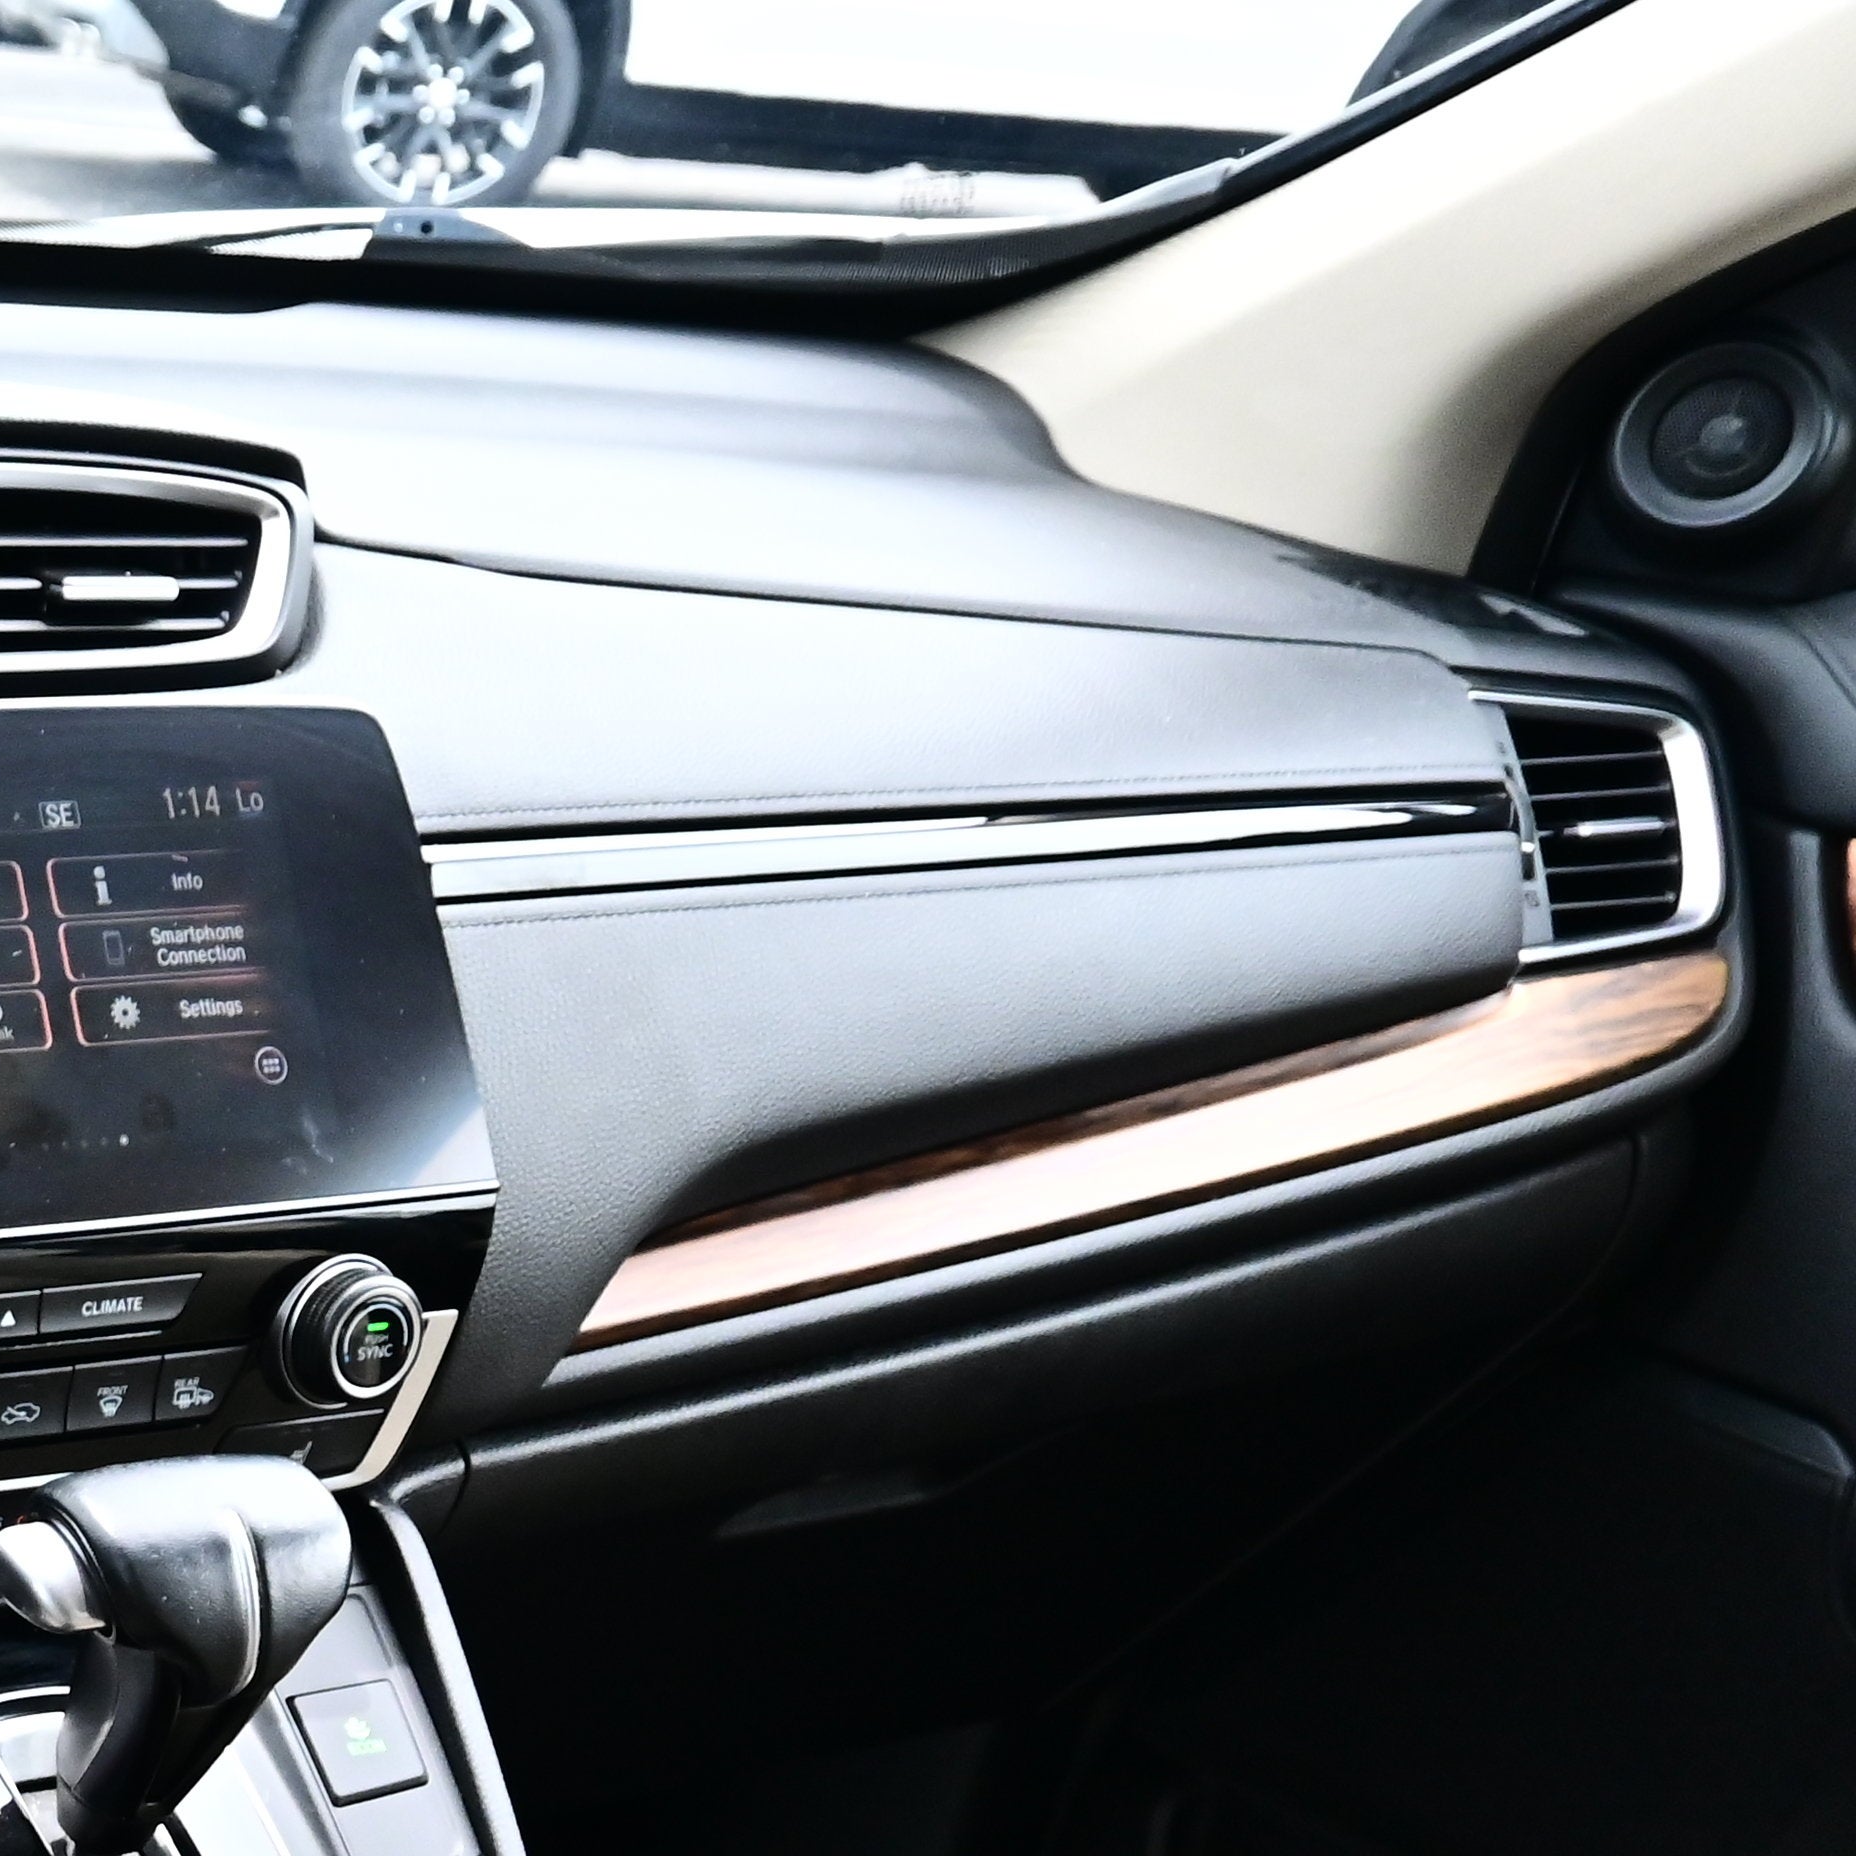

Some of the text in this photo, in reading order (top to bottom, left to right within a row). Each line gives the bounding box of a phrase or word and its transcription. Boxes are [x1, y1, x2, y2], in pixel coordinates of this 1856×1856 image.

[163, 786, 221, 819] 1:14
[172, 873, 203, 891] Info
[150, 924, 244, 947] Smartphone
[157, 946, 247, 967] Connection
[180, 999, 244, 1019] Settings
[81, 1296, 144, 1317] CLIMATE
[357, 1343, 394, 1361] SYNC
[97, 1385, 129, 1397] FRONT
